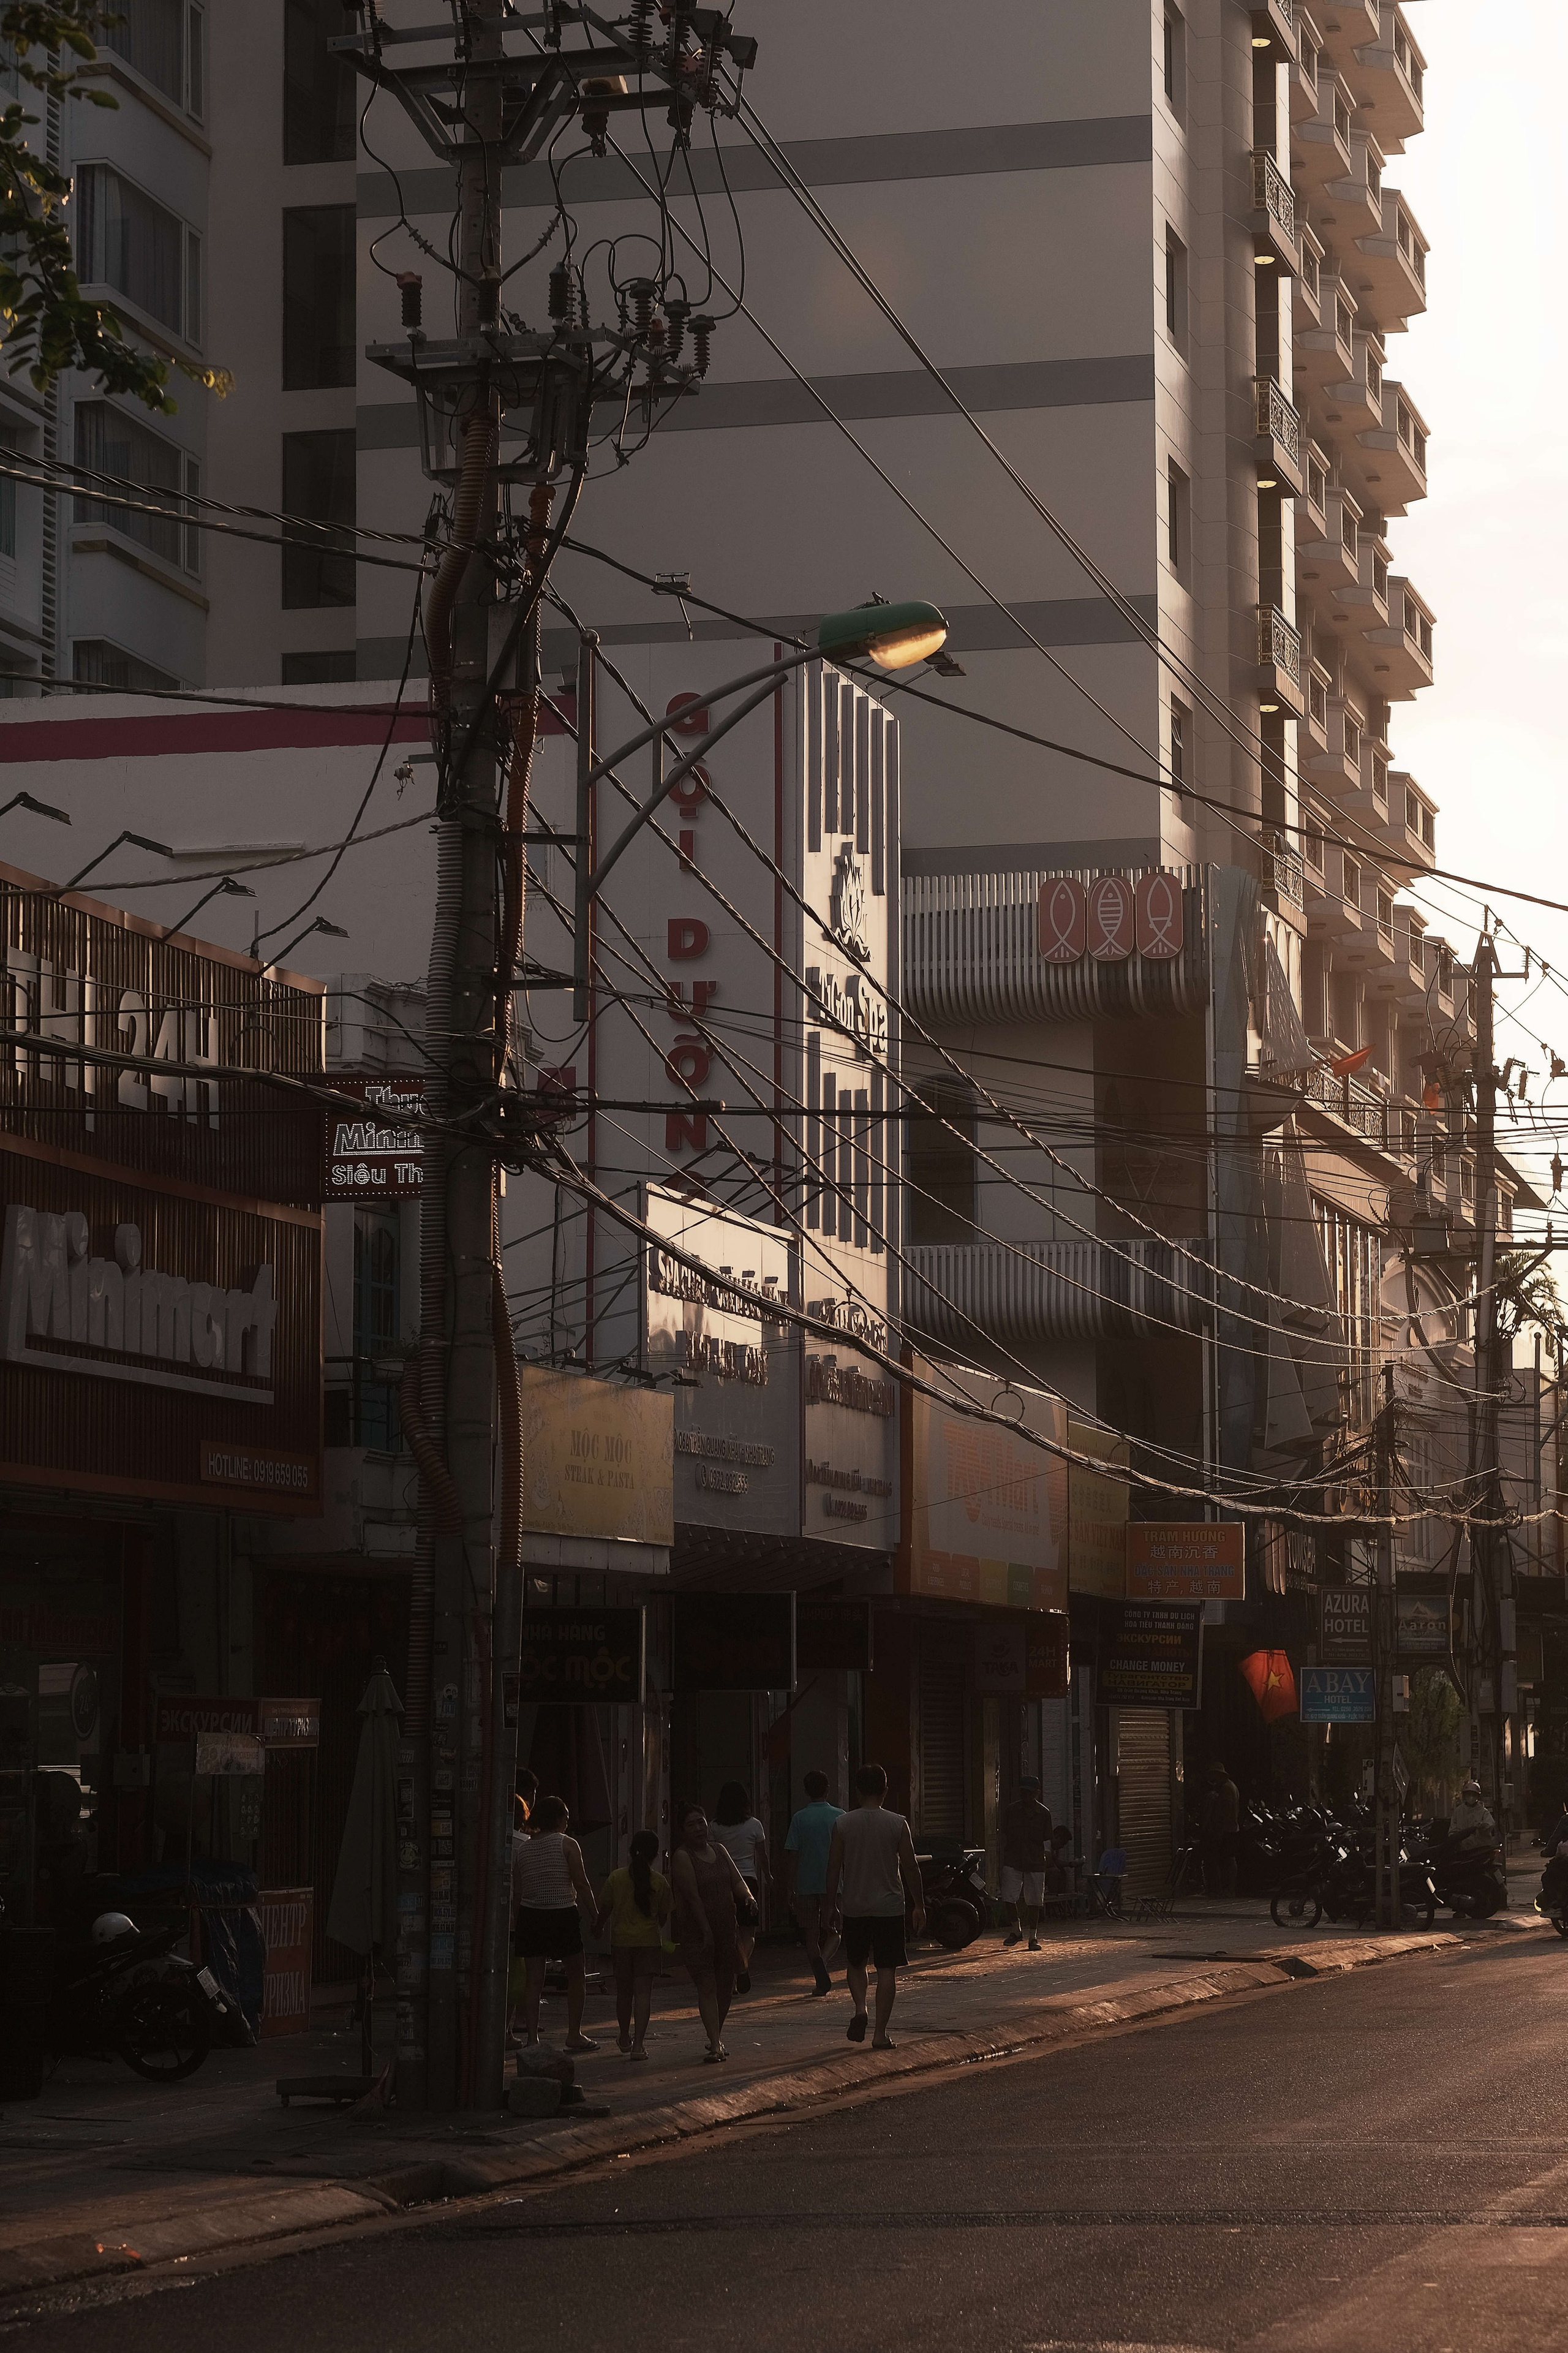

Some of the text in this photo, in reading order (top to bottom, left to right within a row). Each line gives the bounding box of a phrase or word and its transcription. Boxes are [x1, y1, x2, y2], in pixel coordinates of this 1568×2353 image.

[858, 975, 889, 1055] Spa
[118, 990, 220, 1131] 24H
[331, 1163, 386, 1185] Siêu
[4, 1204, 278, 1381] Minimart
[570, 1427, 632, 1468] MỘC MỘC
[208, 1452, 308, 1488] HOTLINE: 0919 659 055
[564, 1464, 635, 1490] STEAK & PASTA
[1150, 1544, 1218, 1560] 越南沉香
[1180, 1565, 1200, 1577] NHA
[1202, 1565, 1235, 1578] TRANG
[1324, 1594, 1370, 1614] AZURA
[1152, 1611, 1168, 1620] TNHH
[559, 1620, 606, 1641] HÀNG
[1324, 1618, 1369, 1633] HOTEL
[1398, 1620, 1447, 1631] Aaron
[1116, 1633, 1182, 1645] ЭКСКУРСИИ
[1028, 1645, 1056, 1656] 24H
[981, 1661, 1019, 1677] TAKA
[1028, 1658, 1058, 1669] MART
[1109, 1659, 1185, 1672] CHANGE MONEY
[1105, 1671, 1190, 1682] Турагентство
[1107, 1679, 1187, 1688] НАВИГАТОР
[1306, 1672, 1371, 1693] ABAY
[1324, 1695, 1352, 1704] HOTEL
[161, 1709, 253, 1734] ЭКСКУРСИИ
[261, 1902, 307, 1962] ЦЕНТР
